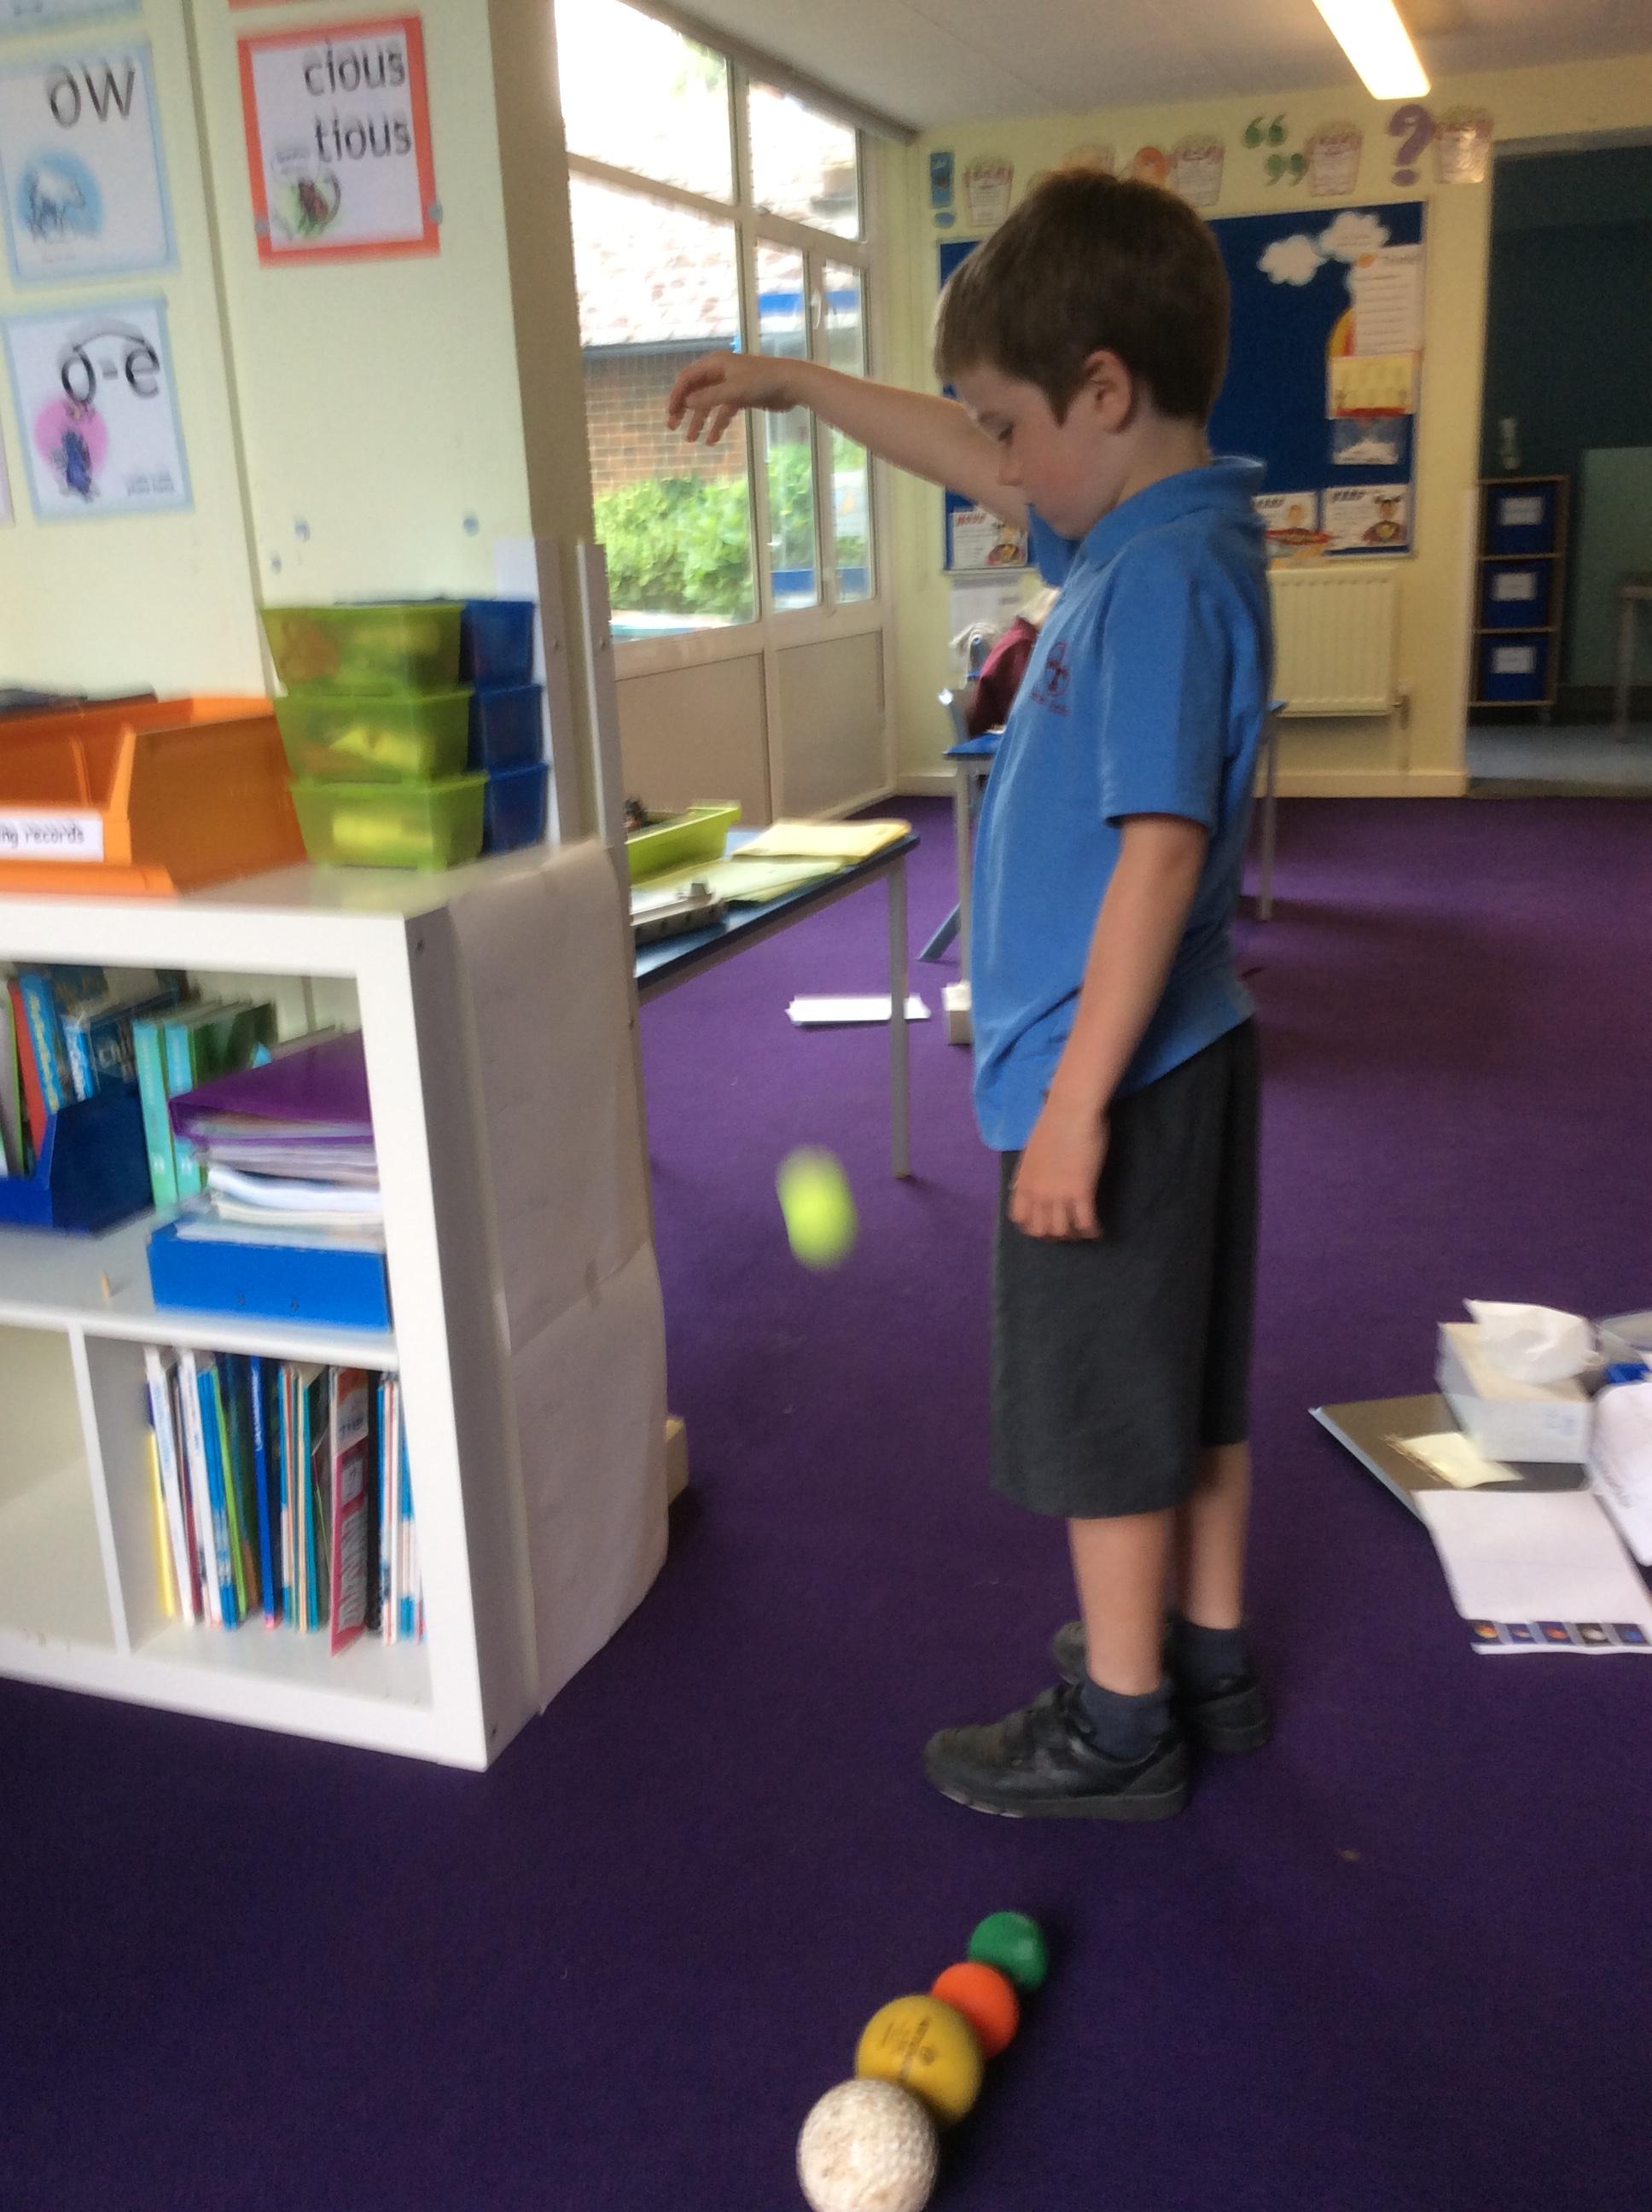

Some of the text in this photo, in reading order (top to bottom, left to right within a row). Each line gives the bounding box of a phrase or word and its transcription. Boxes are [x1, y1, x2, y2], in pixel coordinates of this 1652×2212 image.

[49, 60, 136, 128] ow
[303, 46, 405, 96] cious
[315, 113, 411, 163] tious
[25, 823, 84, 844] records
